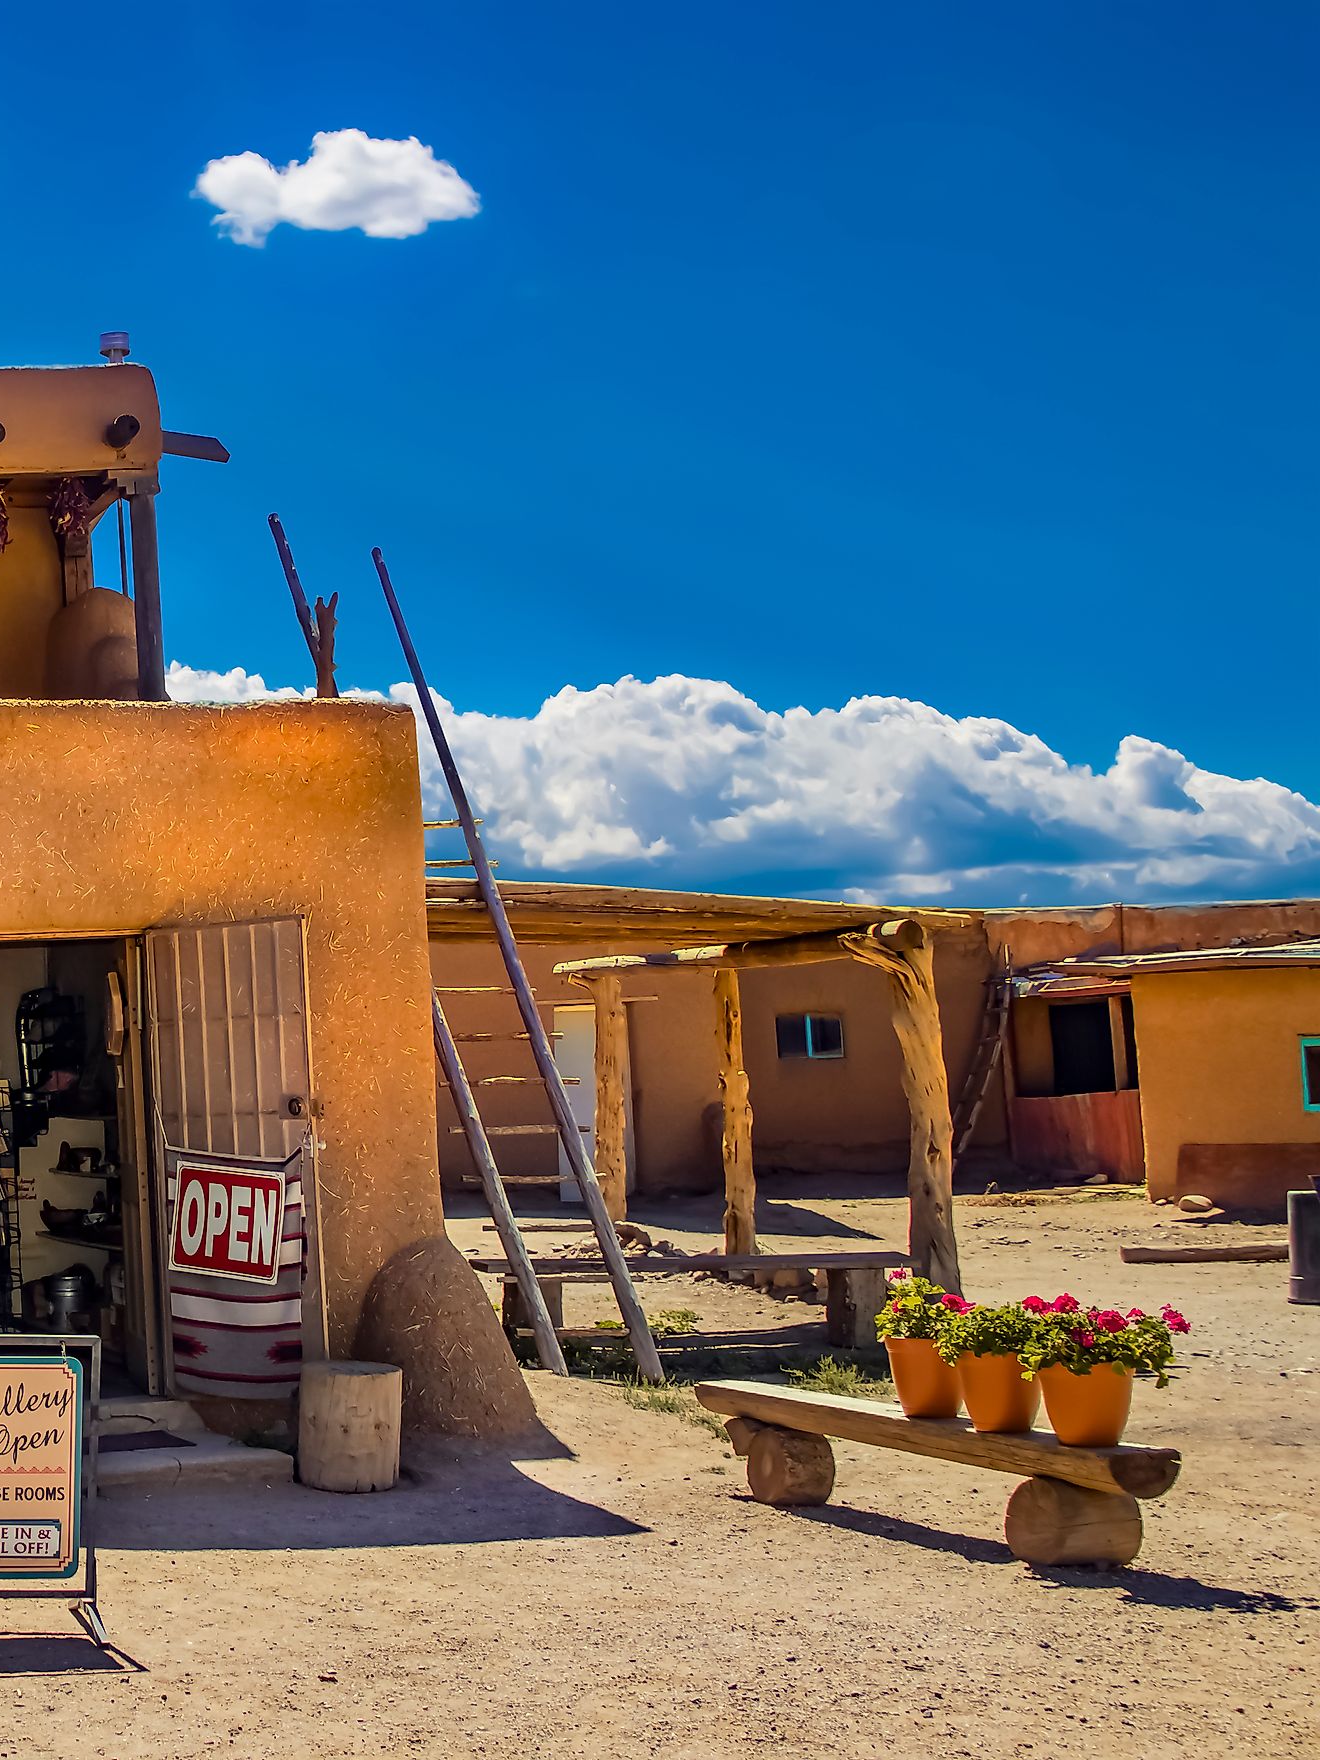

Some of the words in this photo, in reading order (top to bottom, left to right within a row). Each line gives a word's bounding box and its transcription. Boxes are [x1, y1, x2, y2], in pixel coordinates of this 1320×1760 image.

[180, 1179, 277, 1266] OPEN
[14, 1486, 65, 1501] ROOMS
[14, 1527, 32, 1539] IN
[37, 1529, 52, 1539] &
[13, 1542, 49, 1554] OFF!
